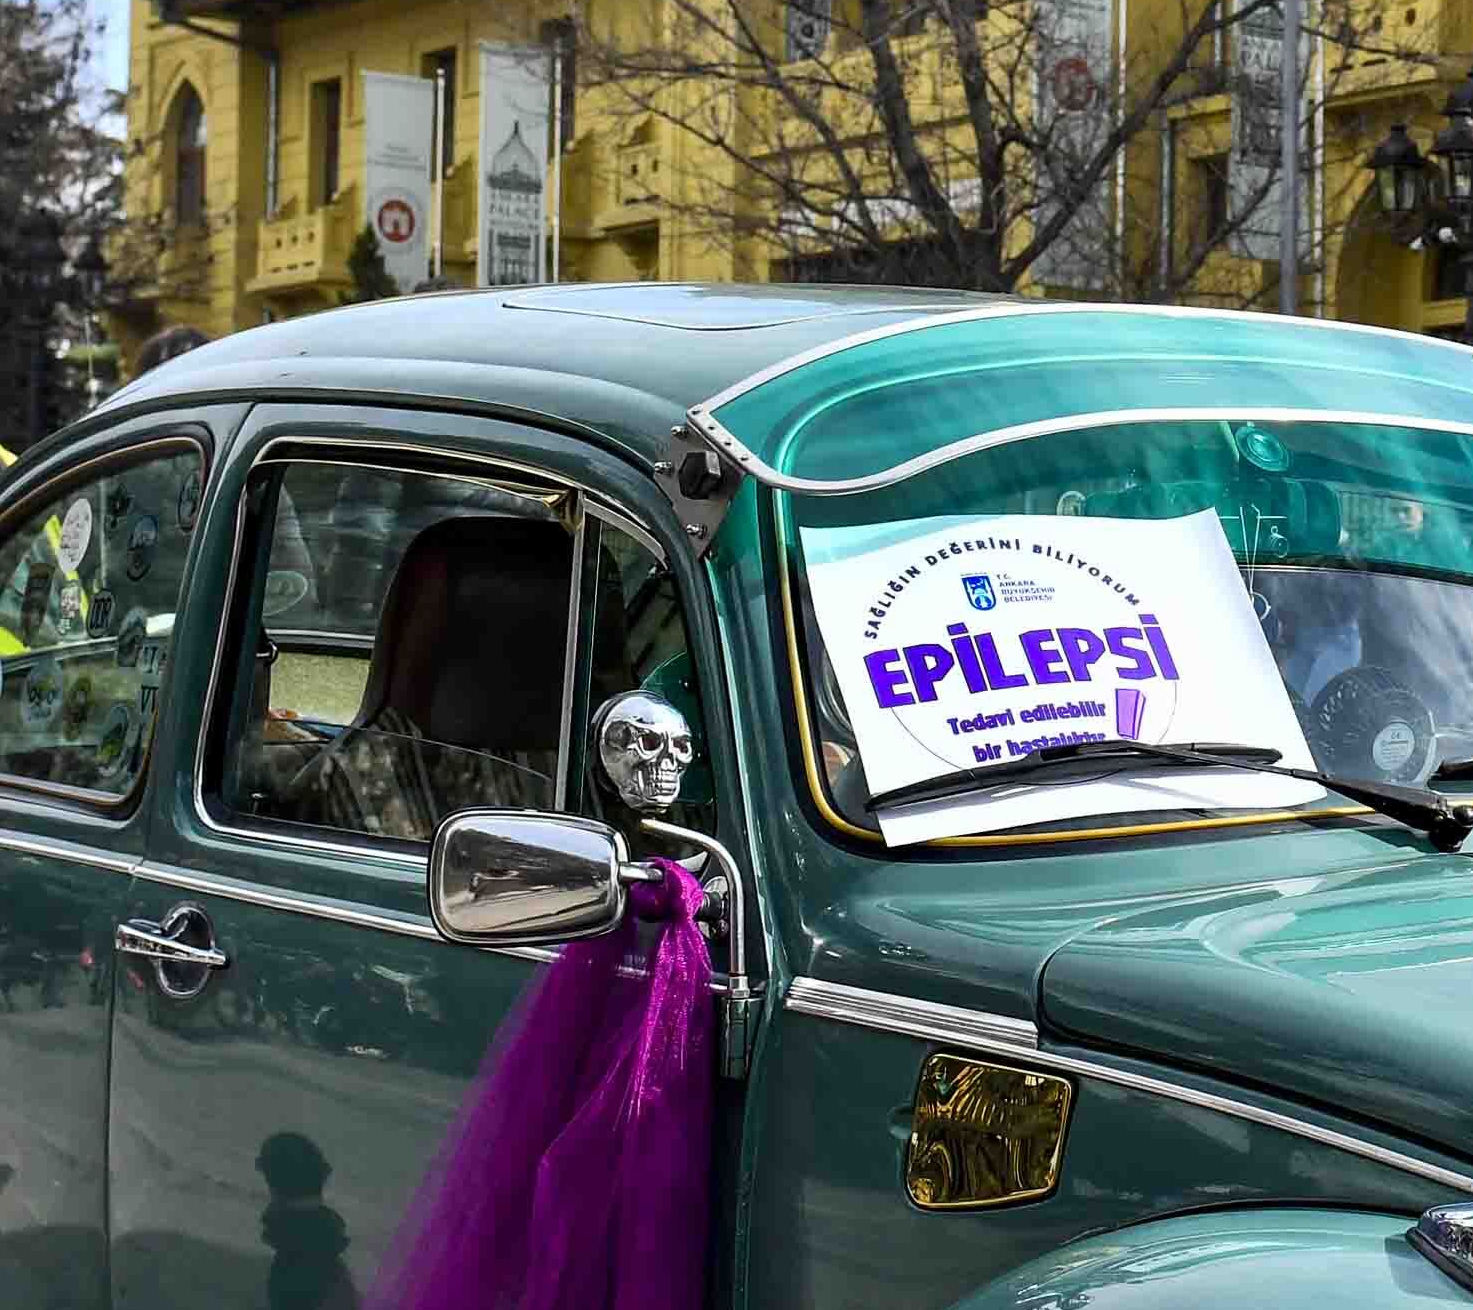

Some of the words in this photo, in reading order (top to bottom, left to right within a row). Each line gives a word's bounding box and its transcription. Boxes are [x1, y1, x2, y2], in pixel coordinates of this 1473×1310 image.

[864, 565, 921, 640] SAĞLIĞIN
[924, 536, 1021, 567] DEĞERİNİ
[1032, 543, 1140, 606] BİLİYORUM
[863, 612, 1180, 709] EPİLEPSİ
[947, 708, 1015, 735] Tedavi
[1020, 701, 1106, 723] edilebilir
[972, 744, 1002, 763] bir
